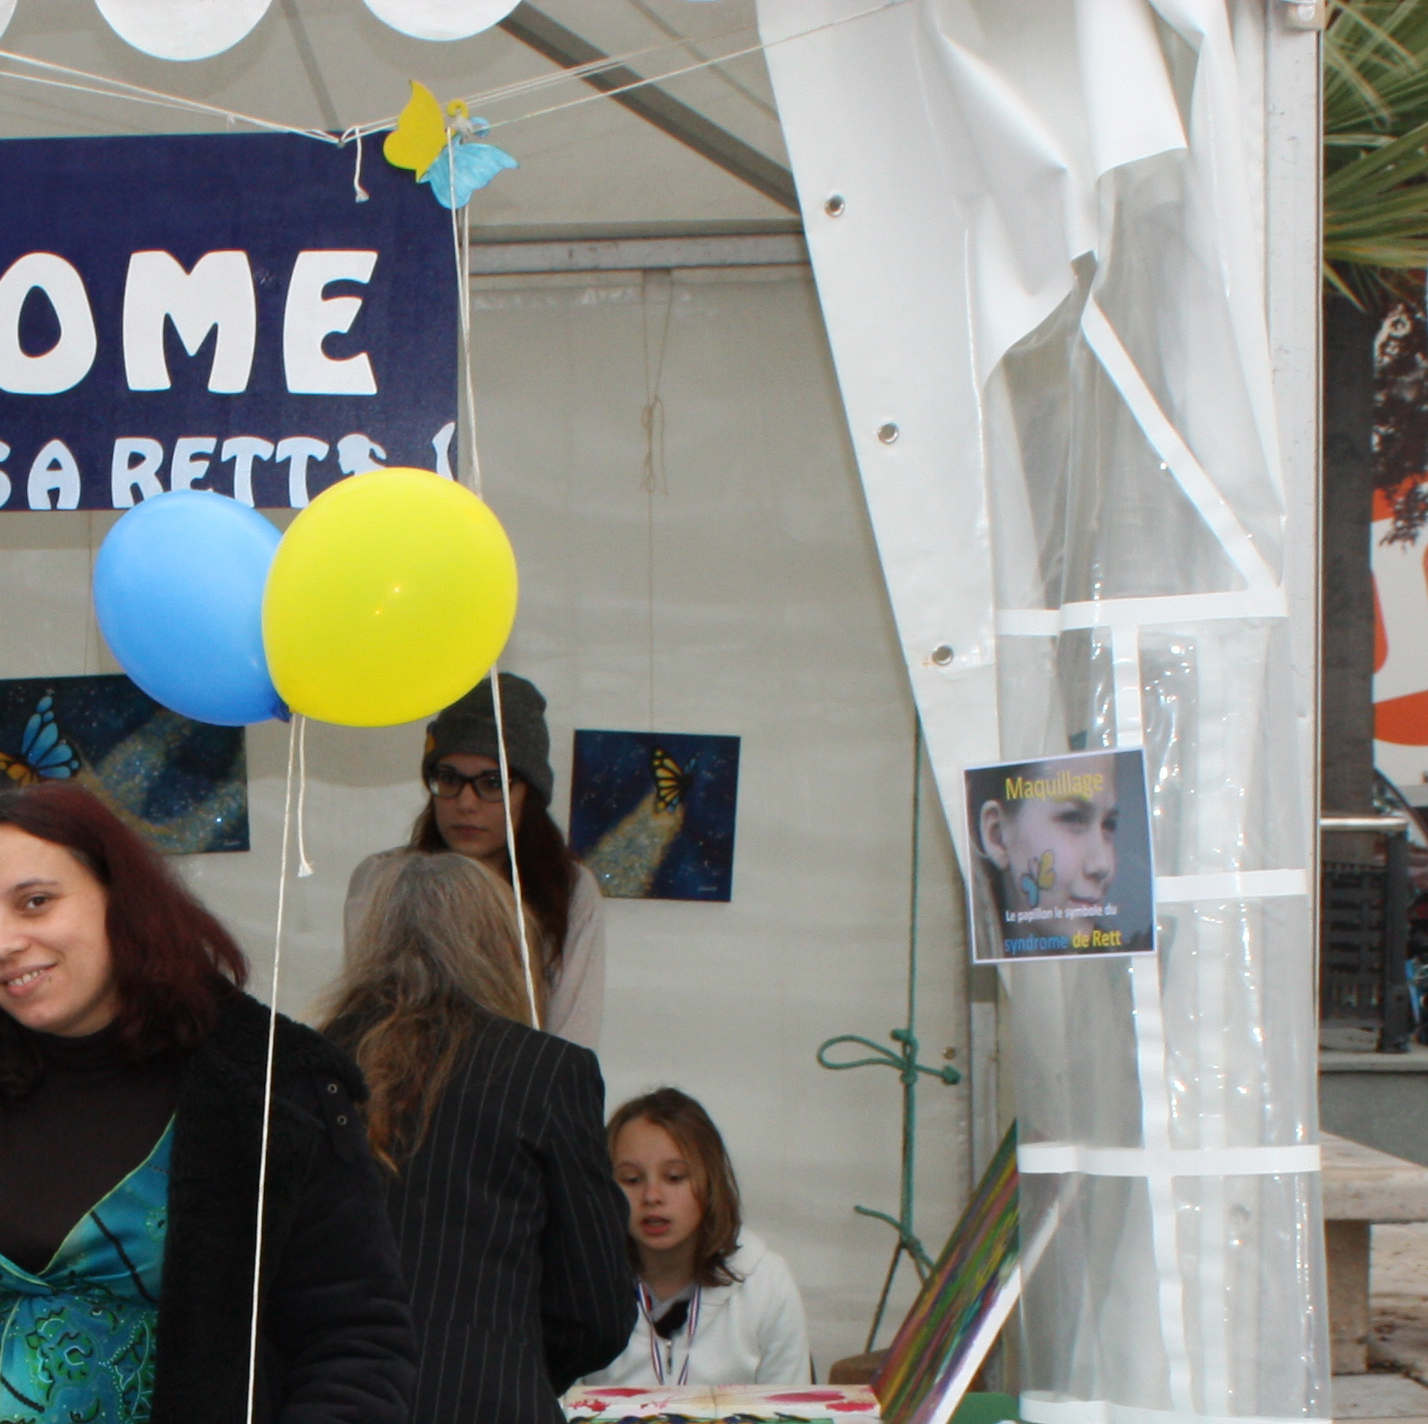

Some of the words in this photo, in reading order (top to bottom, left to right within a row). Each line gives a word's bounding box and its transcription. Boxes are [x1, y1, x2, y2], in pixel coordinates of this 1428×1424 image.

[1005, 771, 1104, 801] Maquillage
[1004, 934, 1068, 955] syndrome
[1072, 930, 1089, 948] de
[1093, 929, 1122, 947] Rett
